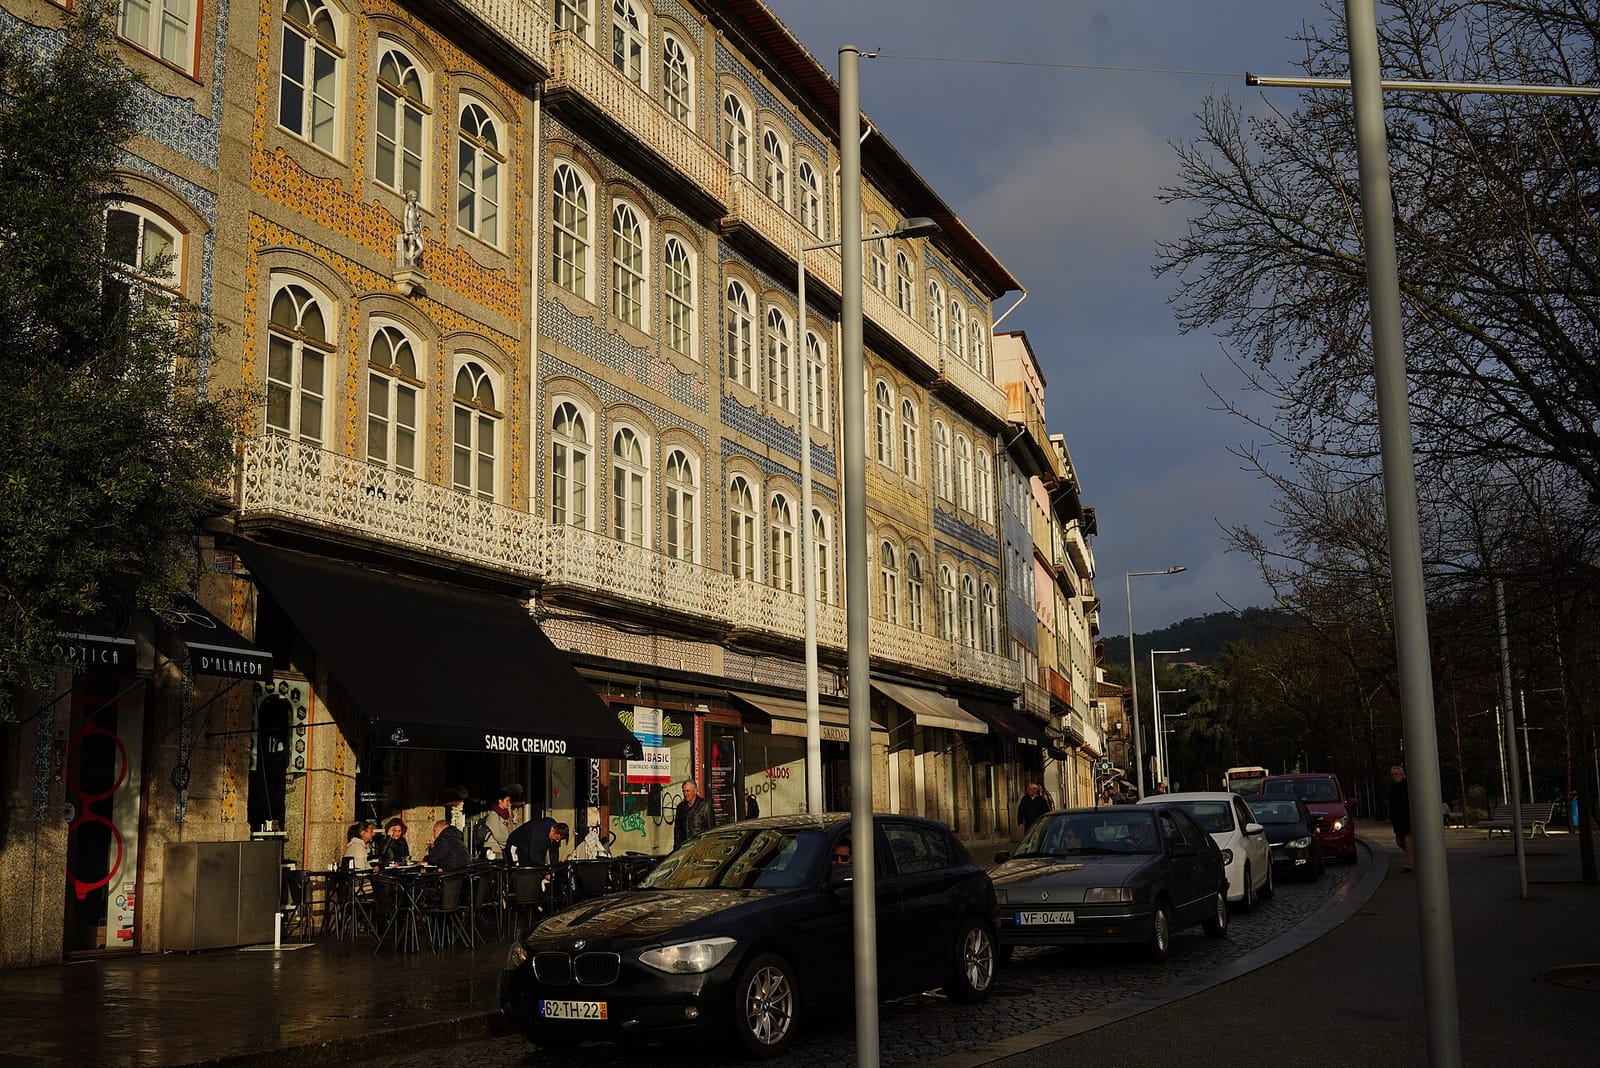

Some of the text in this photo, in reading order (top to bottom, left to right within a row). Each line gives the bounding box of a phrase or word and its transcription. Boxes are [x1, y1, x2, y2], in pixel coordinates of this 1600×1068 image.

[201, 656, 263, 676] D'ALAMEDA
[484, 734, 567, 755] SABOR CREMOSO
[765, 767, 790, 780] SALDOS
